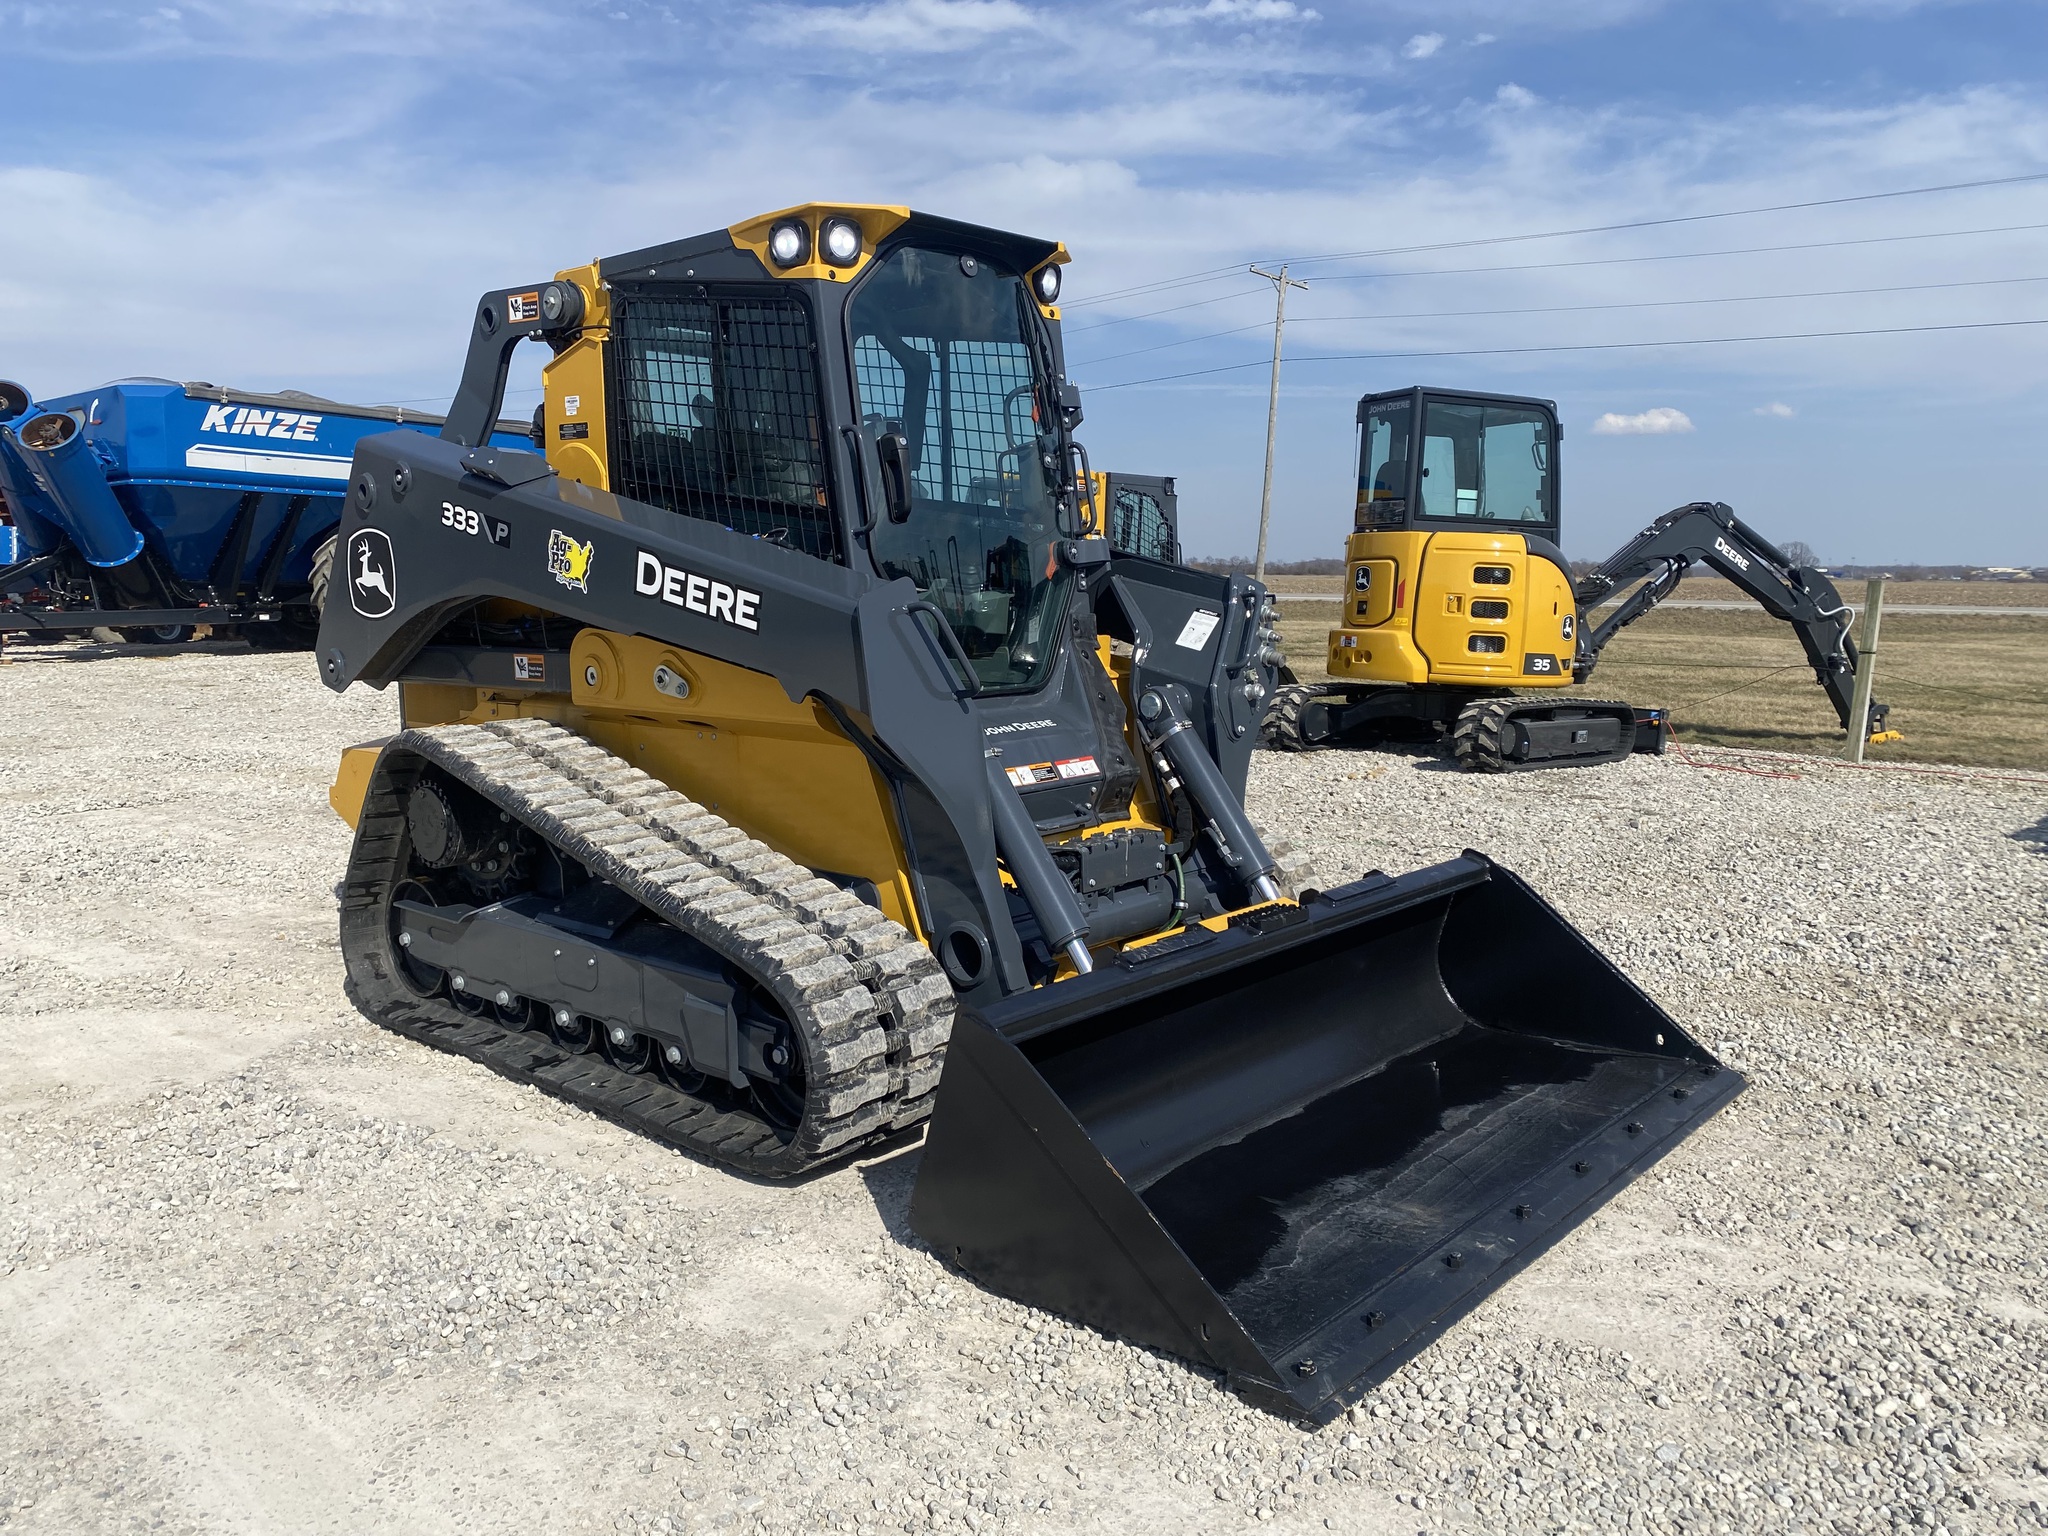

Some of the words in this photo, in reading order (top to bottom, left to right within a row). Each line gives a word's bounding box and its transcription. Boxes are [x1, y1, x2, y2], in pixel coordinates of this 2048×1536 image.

[1369, 404, 1387, 414] JOHN
[1387, 400, 1411, 411] DEERE
[200, 404, 323, 442] KINZE
[551, 533, 572, 557] Ag-
[1714, 536, 1750, 572] DEERE
[550, 552, 571, 573] Pro
[636, 550, 760, 631] DEERE
[1532, 658, 1551, 671] 35
[984, 724, 1017, 736] JOHN
[1011, 719, 1058, 731] DEERE
